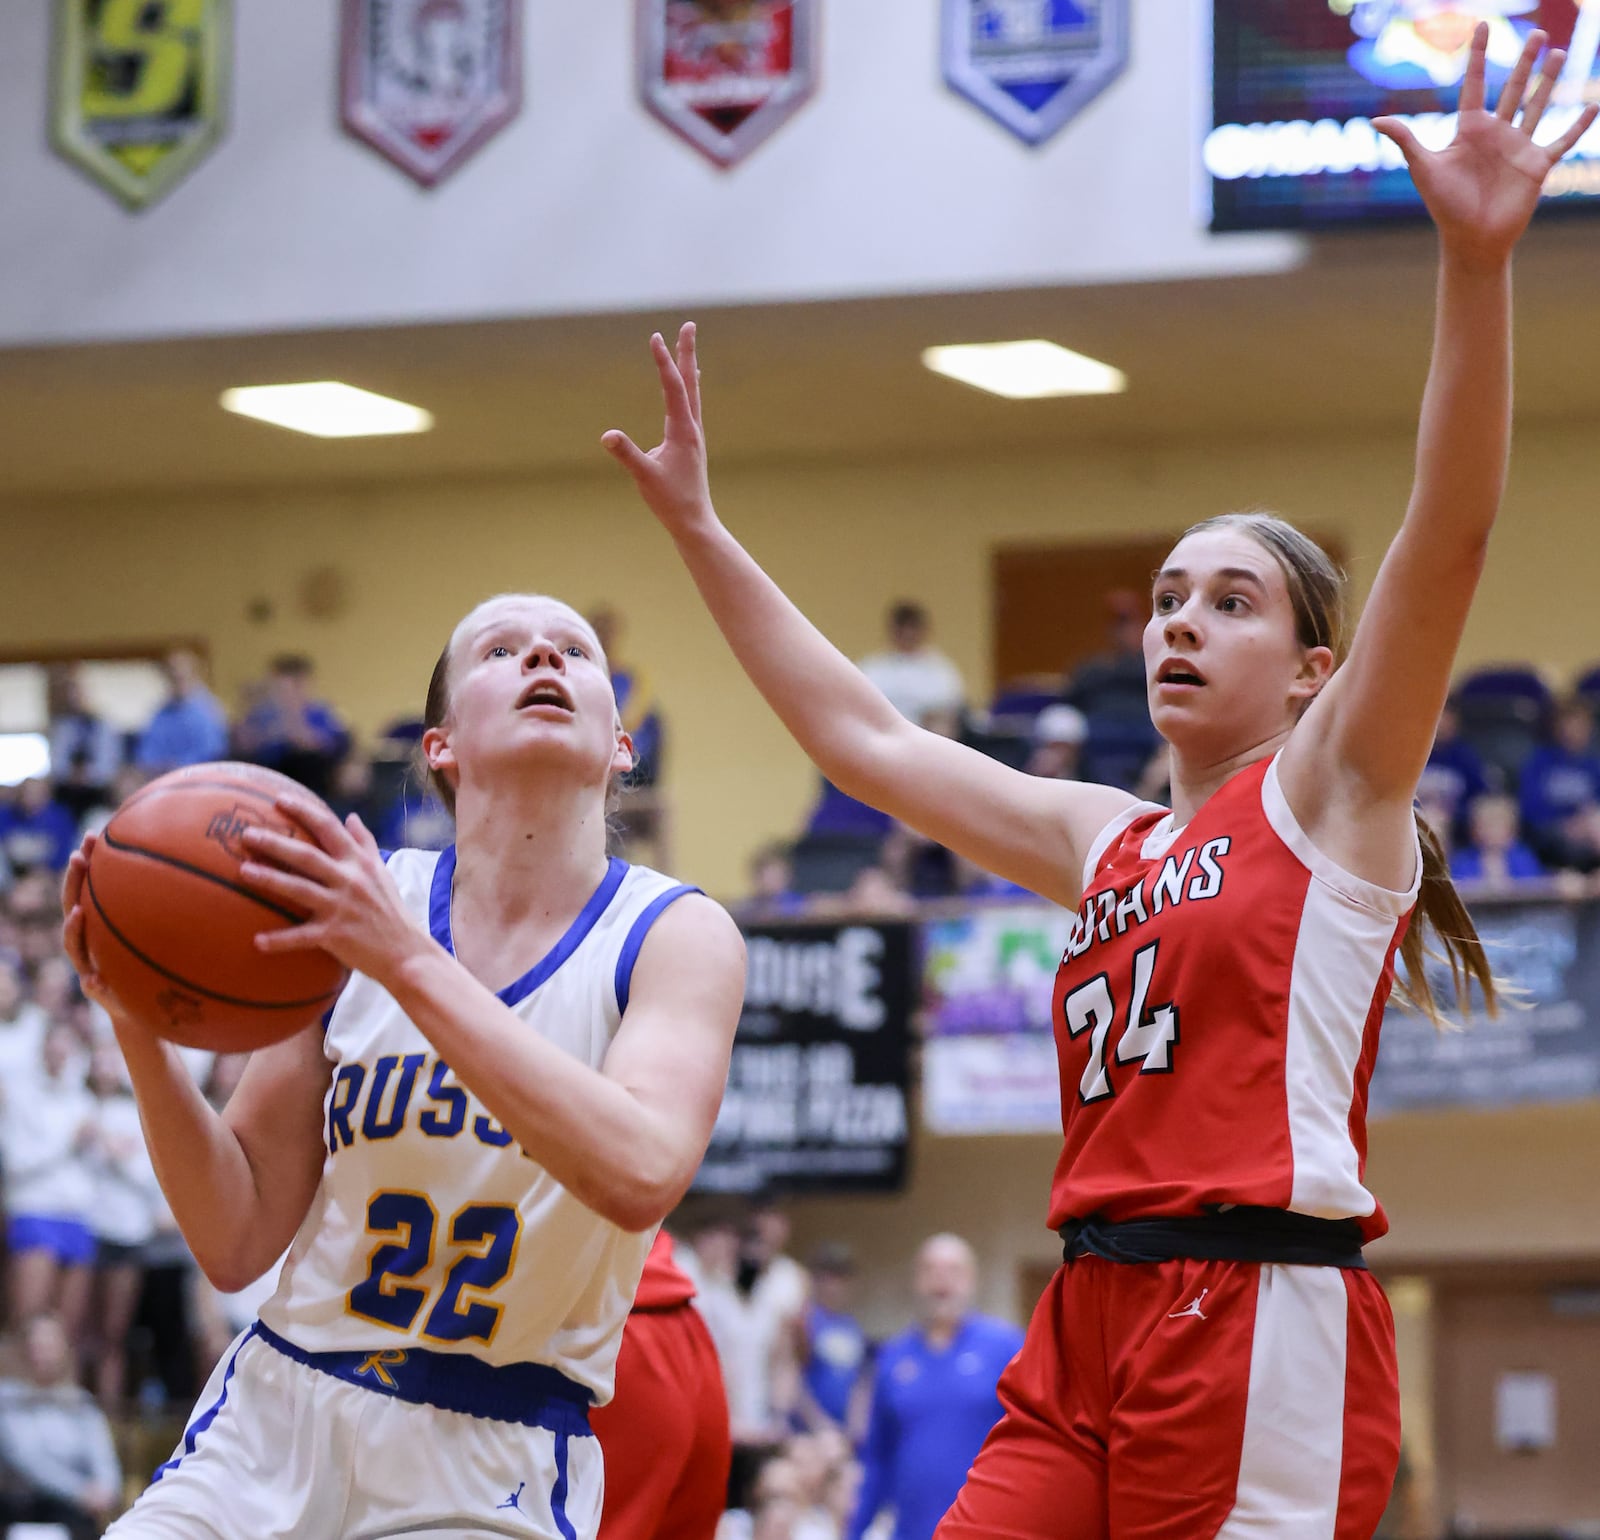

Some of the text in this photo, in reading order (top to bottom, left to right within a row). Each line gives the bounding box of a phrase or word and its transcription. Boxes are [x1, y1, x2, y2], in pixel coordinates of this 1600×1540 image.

[1064, 937, 1181, 1106] 24
[344, 1187, 525, 1348] 22
[353, 1349, 408, 1390] R
